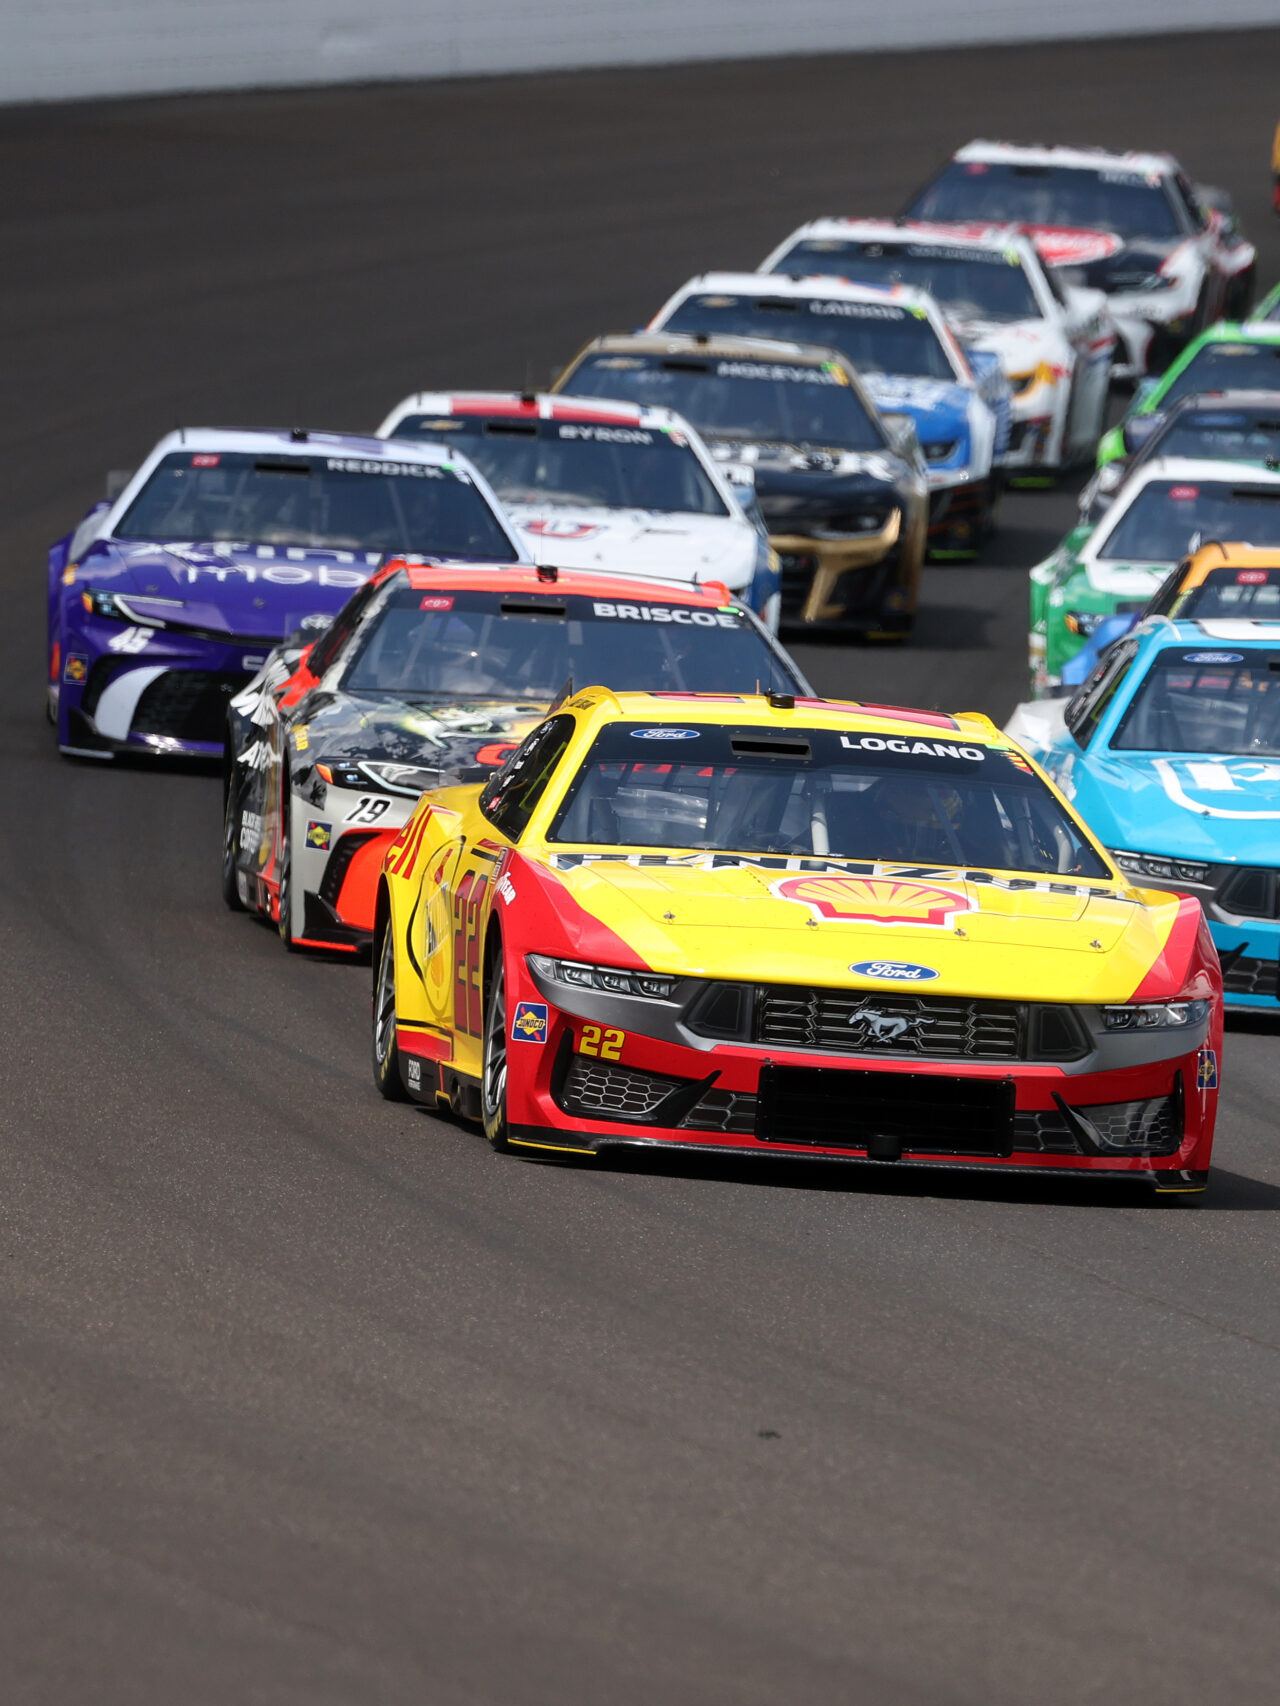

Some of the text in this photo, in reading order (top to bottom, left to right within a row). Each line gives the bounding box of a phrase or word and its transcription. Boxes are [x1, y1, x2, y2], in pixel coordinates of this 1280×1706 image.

[558, 424, 654, 446] BYRON
[326, 457, 445, 480] REDDICK
[592, 601, 740, 631] BRISCOE
[107, 626, 155, 654] 45
[839, 735, 985, 762] LOGANO
[342, 795, 392, 825] 19
[578, 1025, 626, 1061] 22
